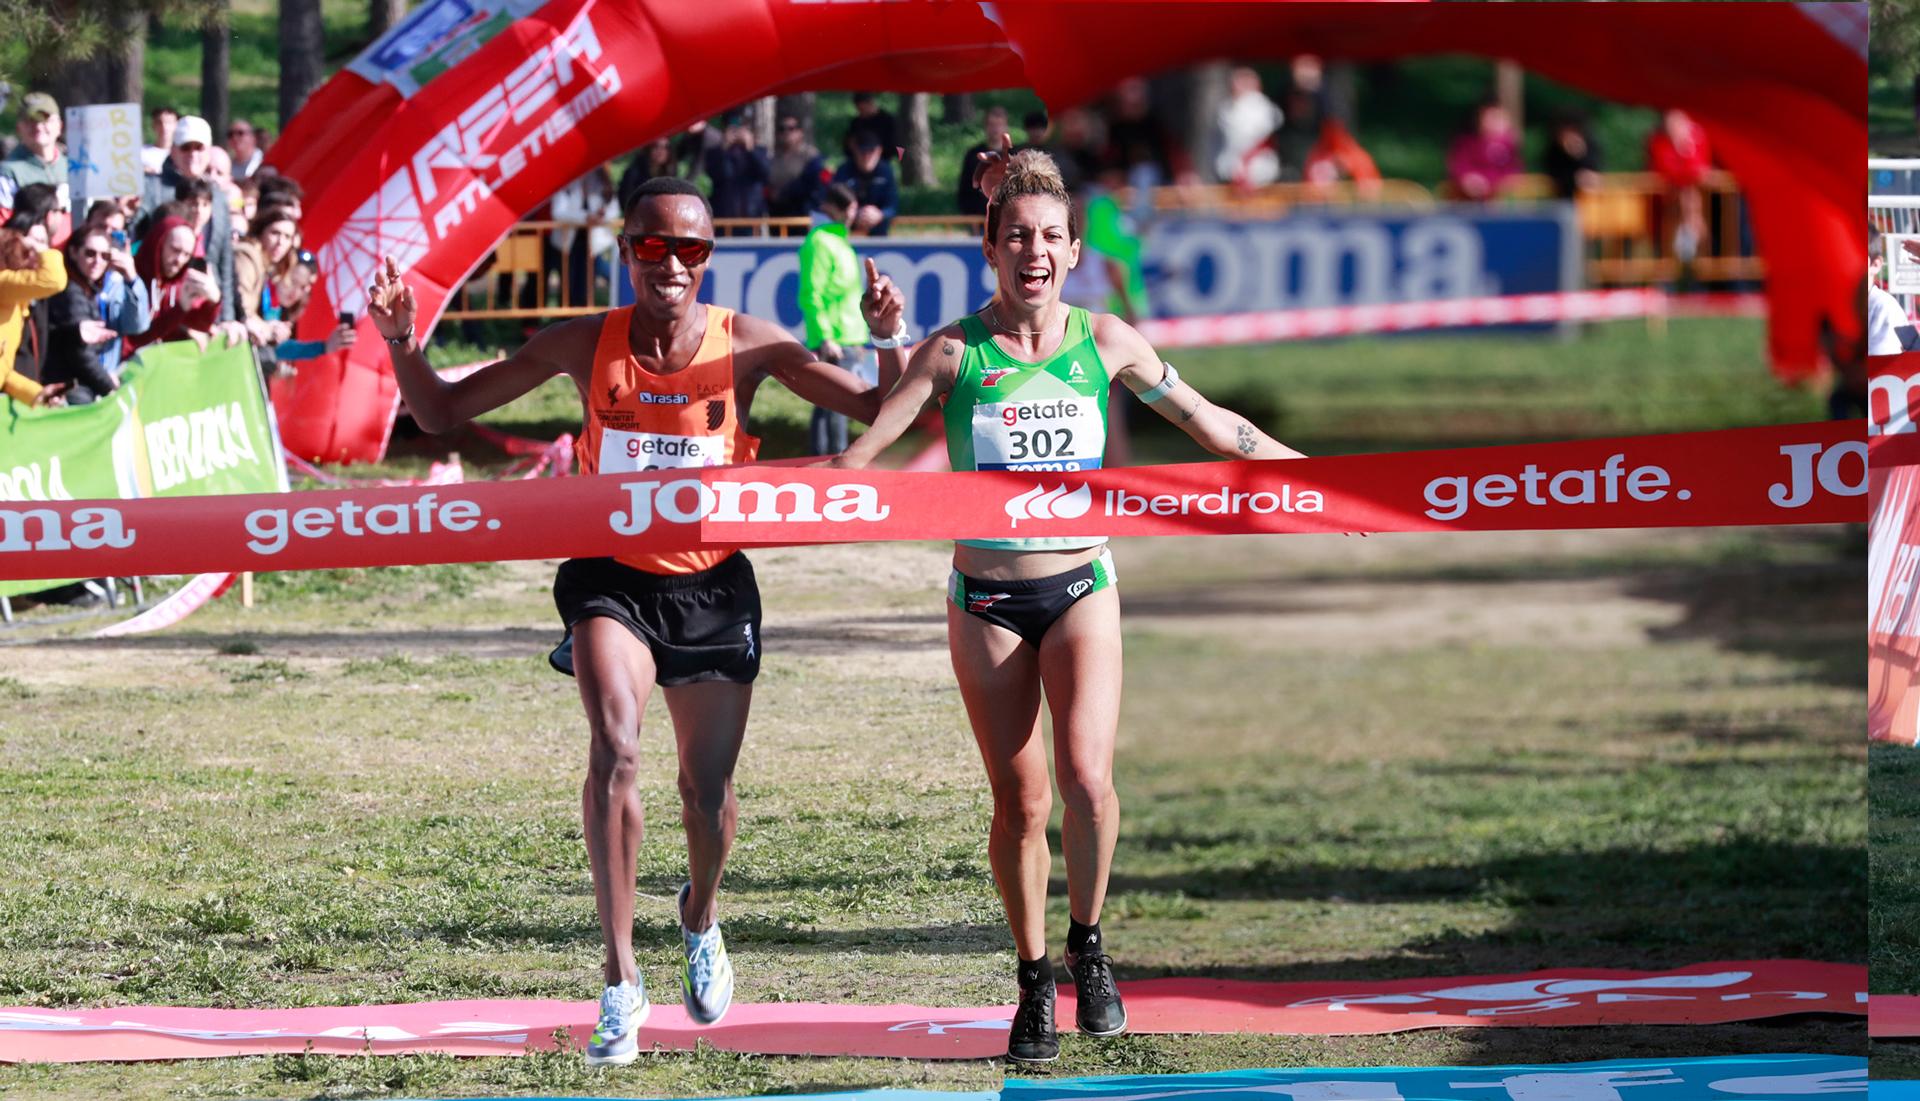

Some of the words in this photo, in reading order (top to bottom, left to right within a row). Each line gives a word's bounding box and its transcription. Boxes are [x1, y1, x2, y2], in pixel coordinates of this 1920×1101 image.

[433, 63, 623, 241] ATLETISMO
[1002, 399, 1084, 426] getafe.
[626, 437, 706, 459] getafe.
[1009, 428, 1075, 460] 302
[1105, 484, 1323, 517] Iberdrola
[1424, 453, 1692, 521] getafe.
[244, 493, 501, 555] getafe.
